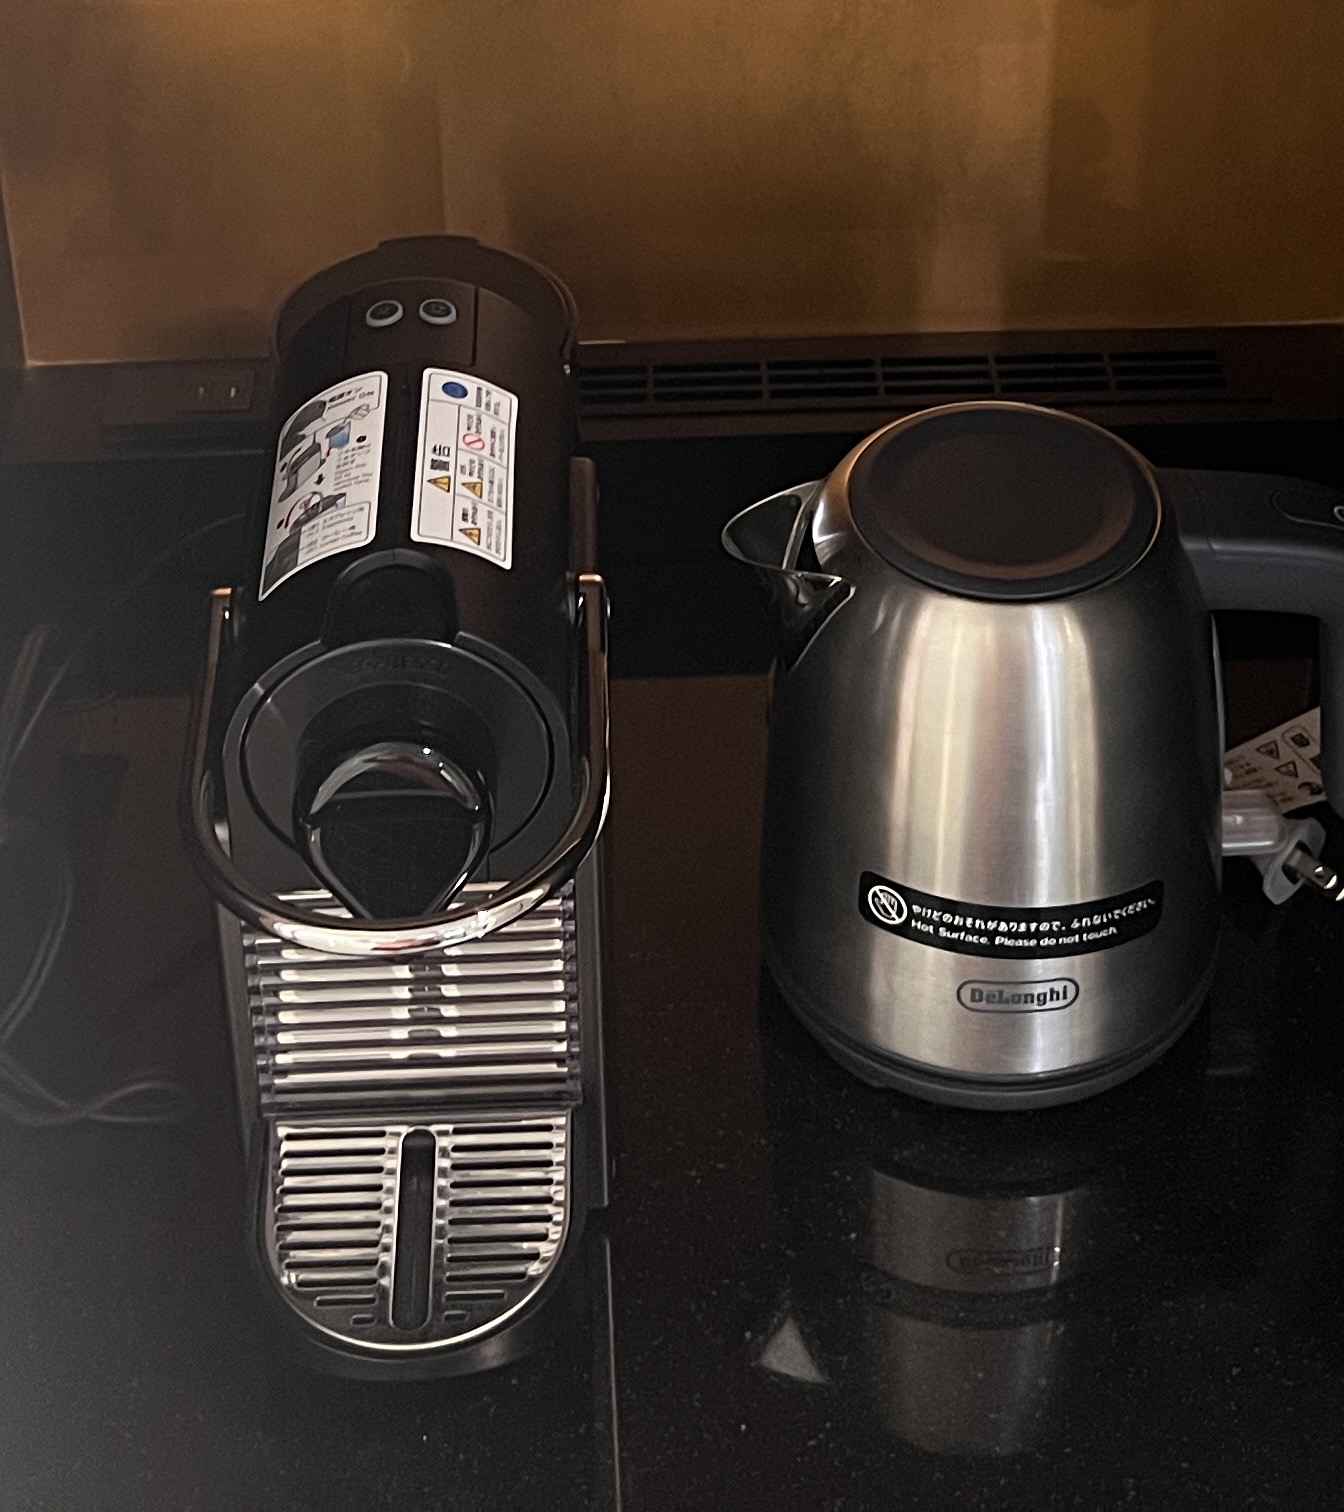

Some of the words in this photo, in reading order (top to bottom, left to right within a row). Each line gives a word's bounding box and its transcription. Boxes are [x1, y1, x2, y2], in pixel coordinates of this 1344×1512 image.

[911, 919, 935, 934] Hot
[994, 935, 1038, 947] Please
[1039, 936, 1057, 947] do
[1058, 934, 1079, 945] not
[1082, 926, 1118, 942] touch
